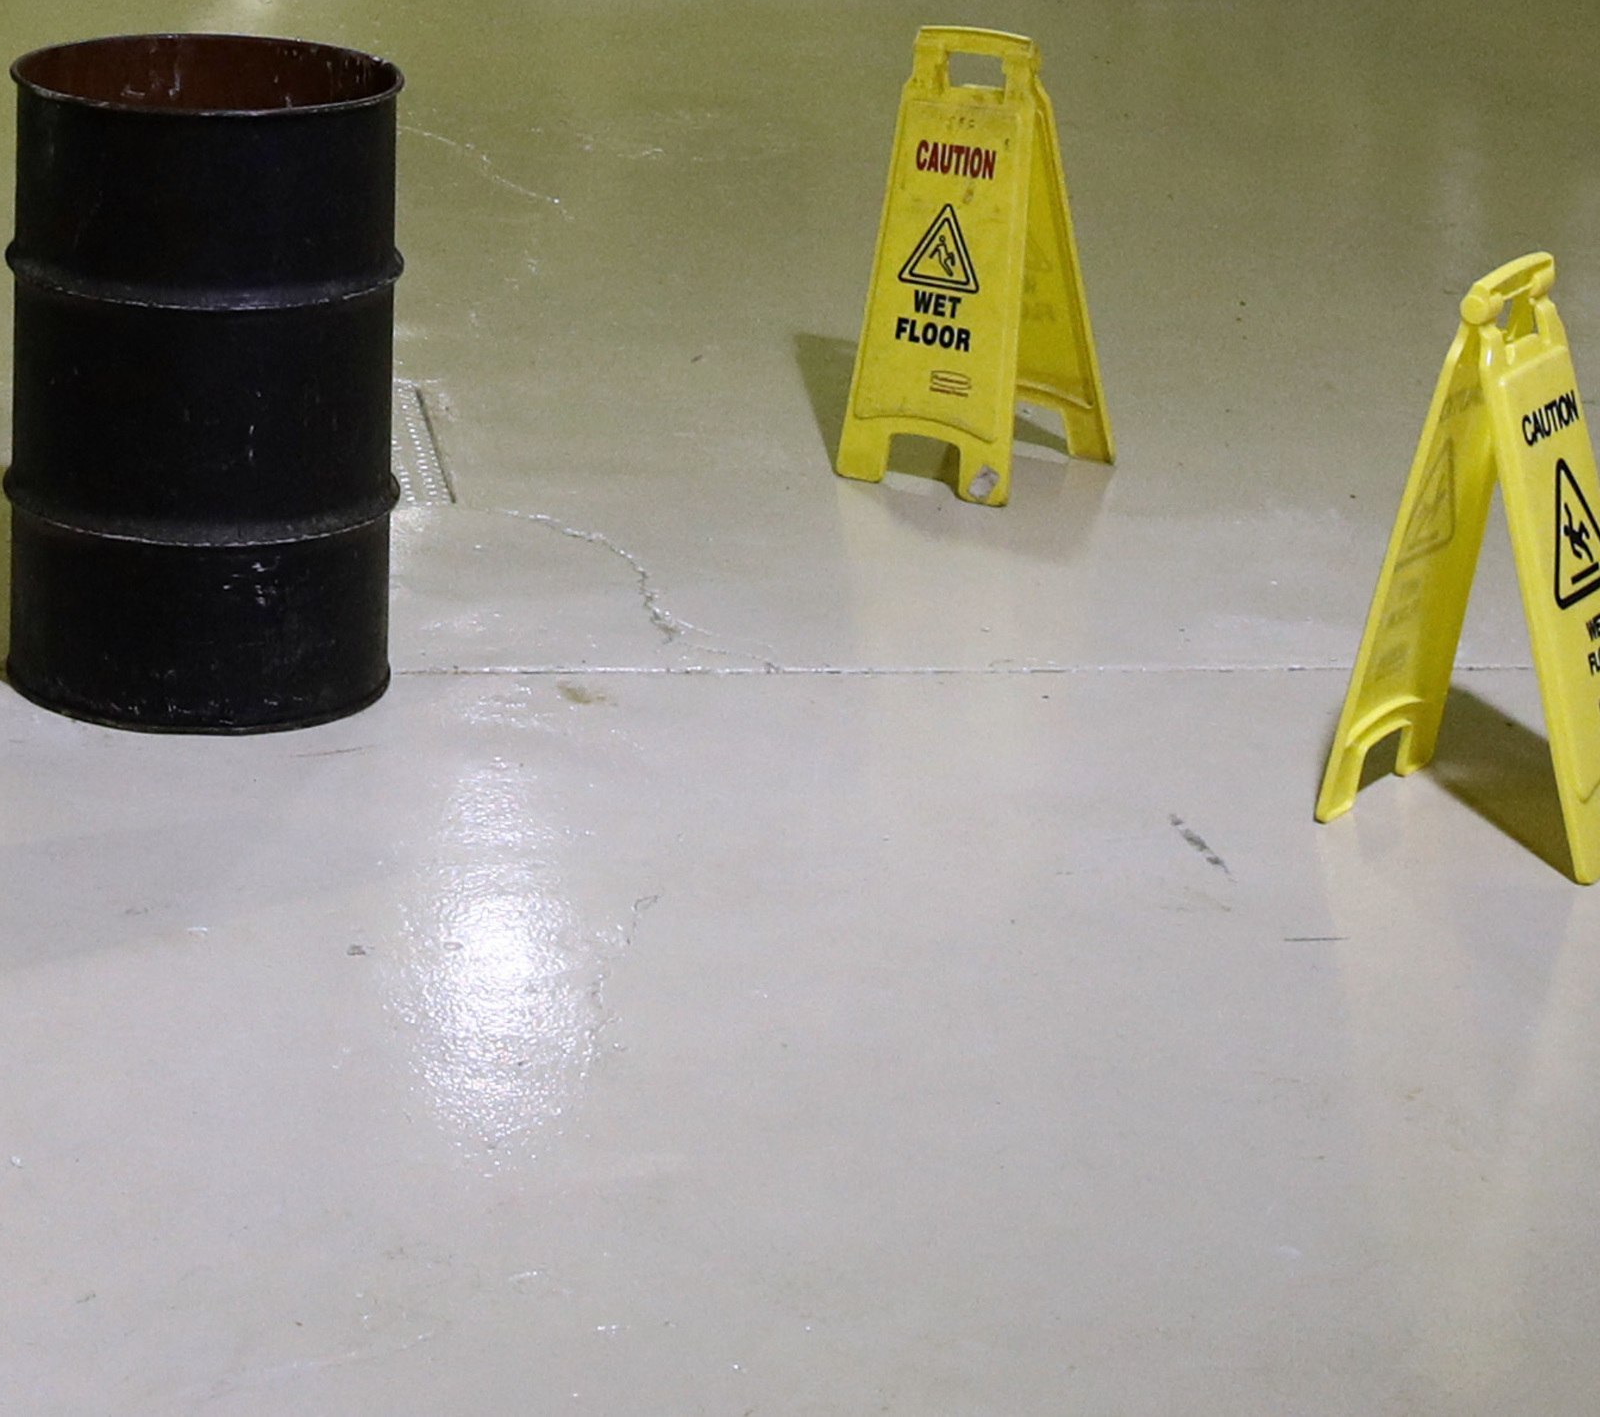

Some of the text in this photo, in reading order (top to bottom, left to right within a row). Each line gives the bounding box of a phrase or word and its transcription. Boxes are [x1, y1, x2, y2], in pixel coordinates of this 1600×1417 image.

[916, 140, 996, 180] CAUTION
[914, 289, 962, 320] WET
[895, 316, 971, 353] FLOOR
[1522, 389, 1580, 447] CAUTION
